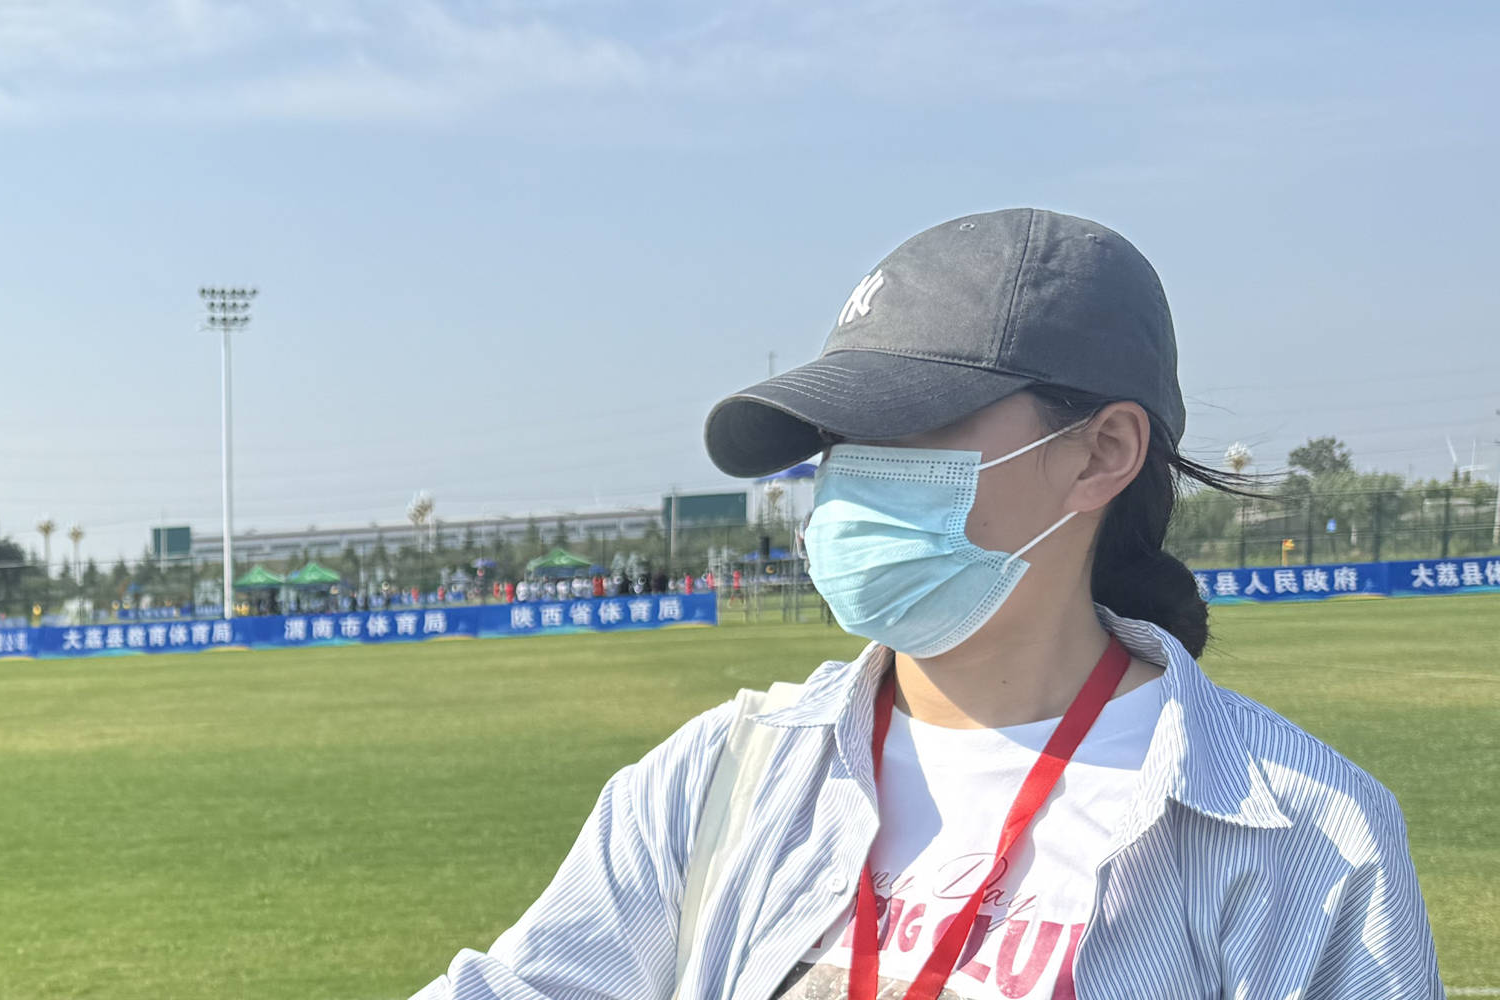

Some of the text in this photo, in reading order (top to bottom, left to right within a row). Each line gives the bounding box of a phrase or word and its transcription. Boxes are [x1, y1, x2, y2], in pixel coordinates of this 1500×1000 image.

[283, 611, 448, 641] 渭南市体育局
[510, 597, 684, 629] 陕西省体育局
[62, 622, 233, 650] 大荔县教育体育局
